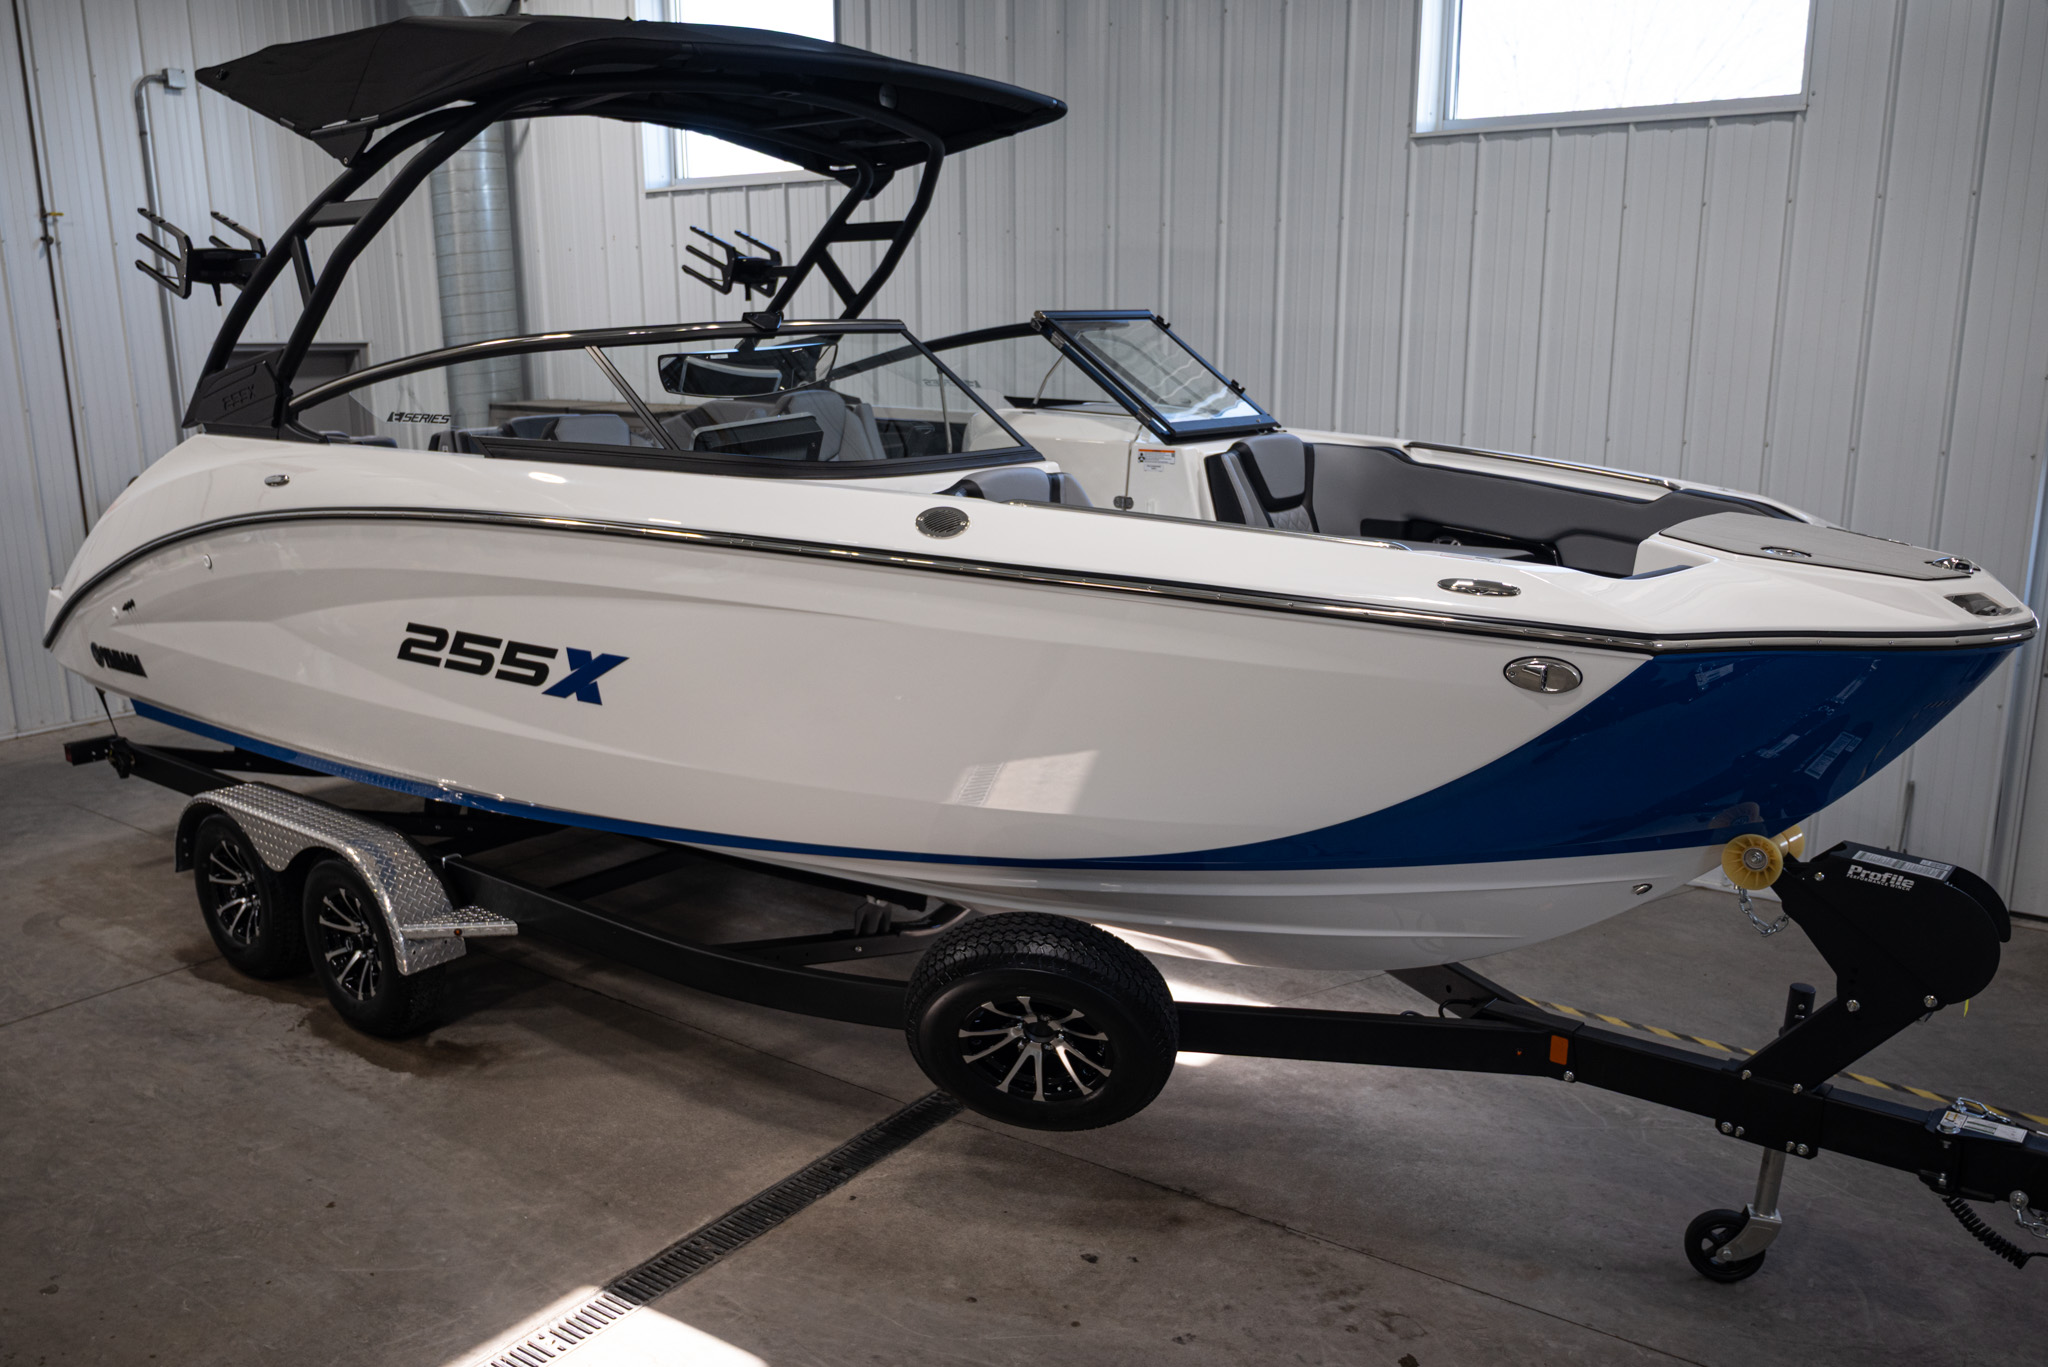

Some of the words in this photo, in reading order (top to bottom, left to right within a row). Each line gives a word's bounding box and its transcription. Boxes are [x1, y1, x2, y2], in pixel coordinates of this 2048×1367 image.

[397, 622, 630, 706] 255X
[1846, 873, 1889, 887] PERFORMANCE
[1847, 864, 1915, 889] Profile
